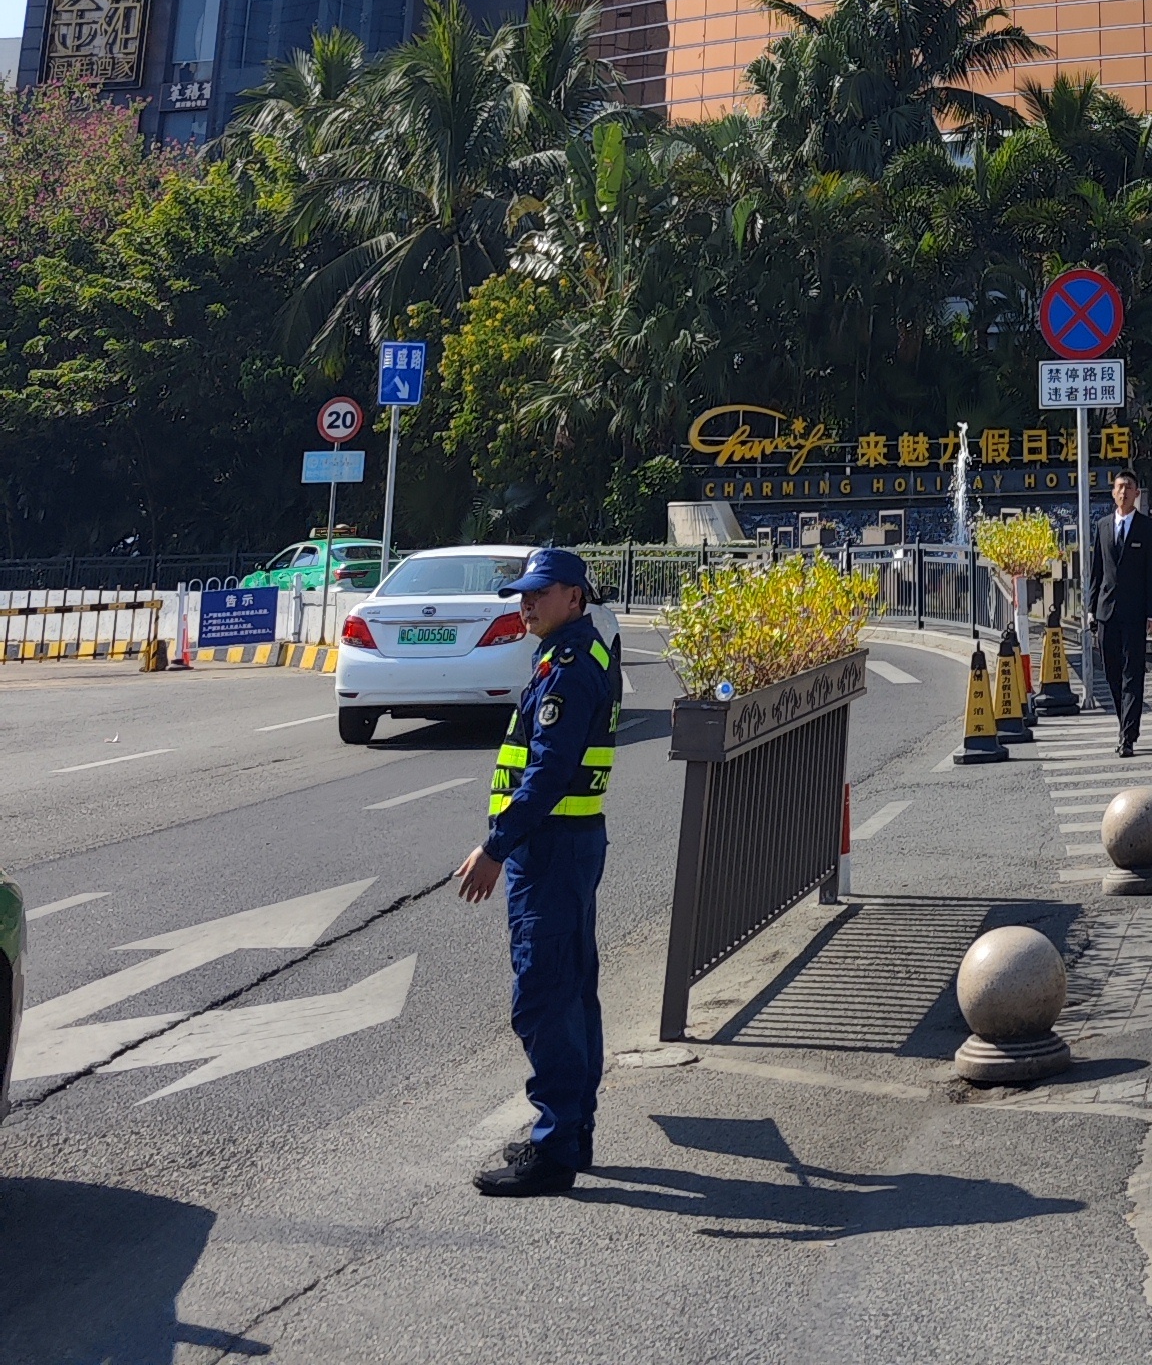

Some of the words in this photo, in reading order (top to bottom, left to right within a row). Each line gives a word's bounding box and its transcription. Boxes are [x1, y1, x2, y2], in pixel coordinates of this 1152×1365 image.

[1047, 366, 1116, 383] 禁停路段
[1047, 385, 1116, 402] 违者拍照
[326, 410, 356, 430] 20
[856, 424, 1131, 469] 来魅力假日酒店
[704, 479, 852, 498] CHARMING
[872, 472, 1004, 495] HOLIAY
[225, 594, 254, 608] 告示
